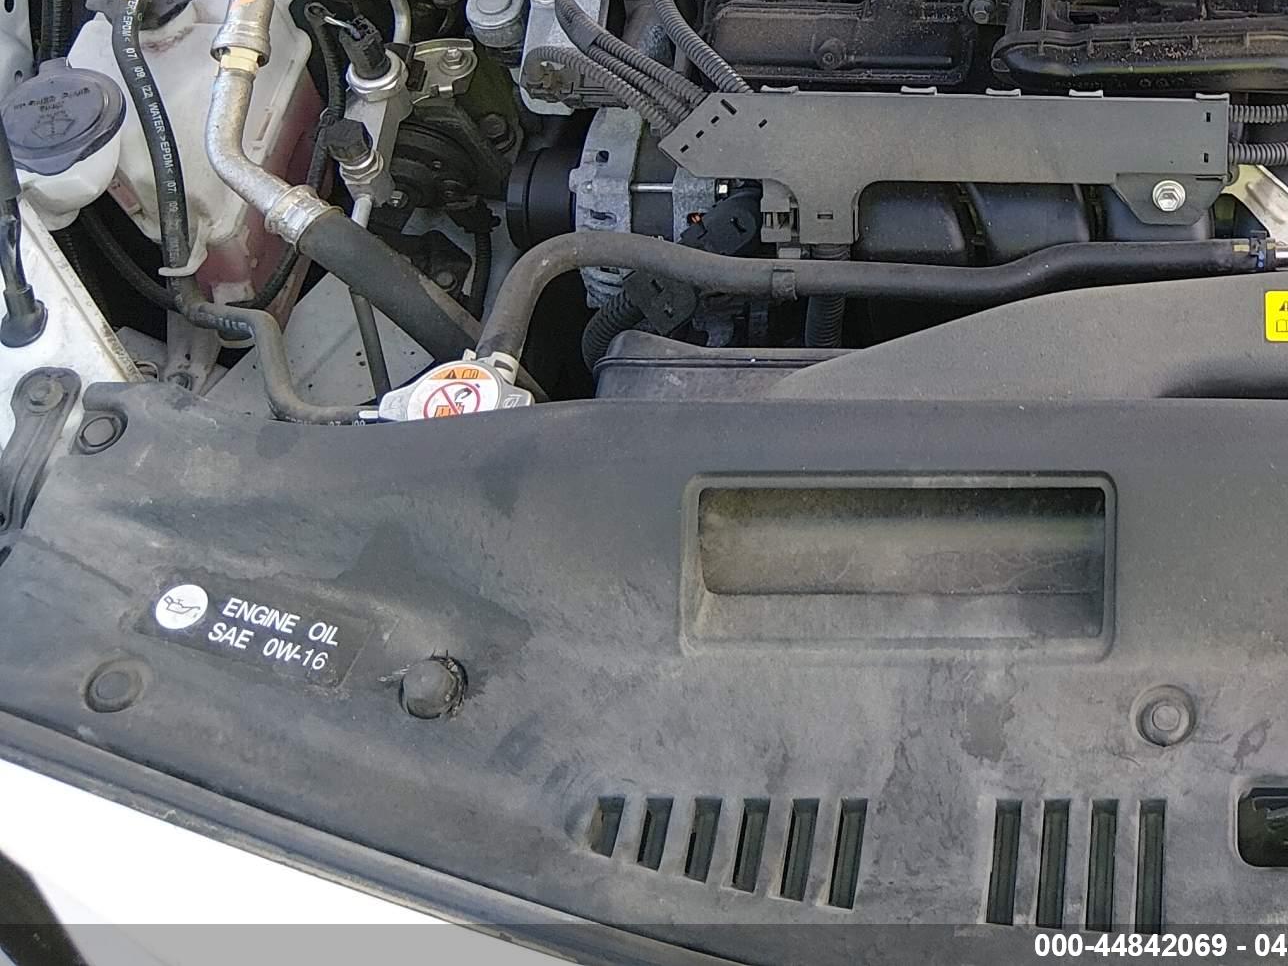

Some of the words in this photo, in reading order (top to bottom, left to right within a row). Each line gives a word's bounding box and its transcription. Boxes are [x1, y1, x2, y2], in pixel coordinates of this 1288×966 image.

[149, 102, 166, 134] WATER
[222, 597, 301, 634] ENGINE
[308, 621, 340, 646] OIL
[208, 622, 254, 650] SAE
[262, 638, 329, 670] 0W-16
